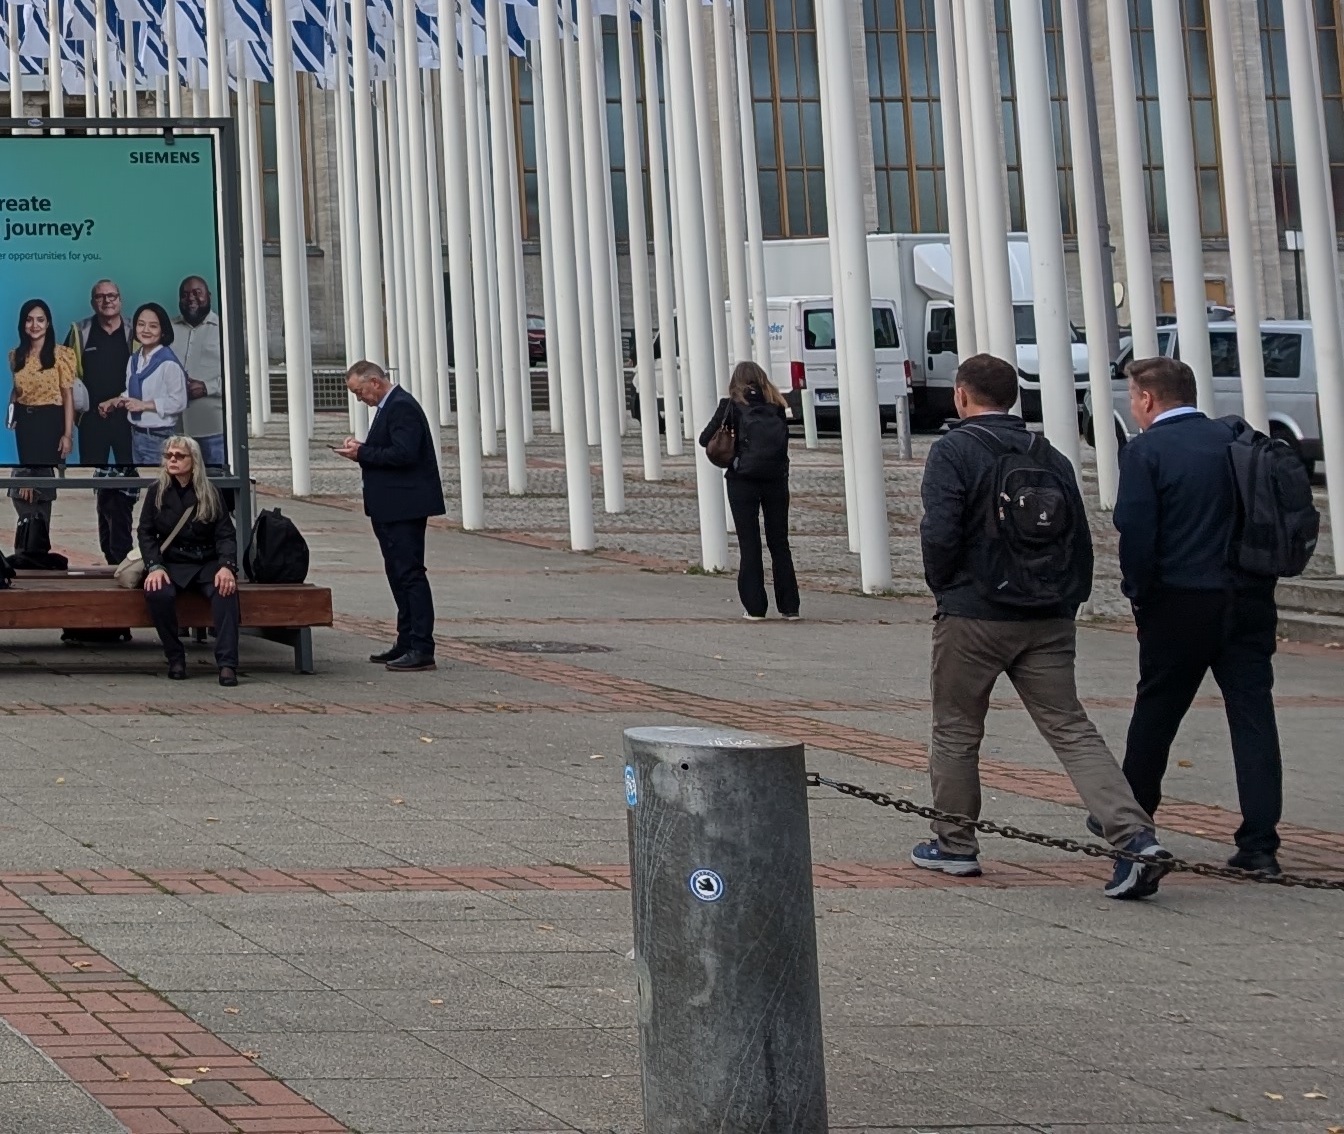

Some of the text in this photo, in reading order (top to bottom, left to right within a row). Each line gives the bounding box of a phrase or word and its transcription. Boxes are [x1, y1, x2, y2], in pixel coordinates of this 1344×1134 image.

[129, 152, 200, 164] SIEMENS
[3, 218, 95, 241] journey?
[8, 251, 67, 262] opportunities
[68, 251, 81, 260] for
[82, 253, 101, 262] you.
